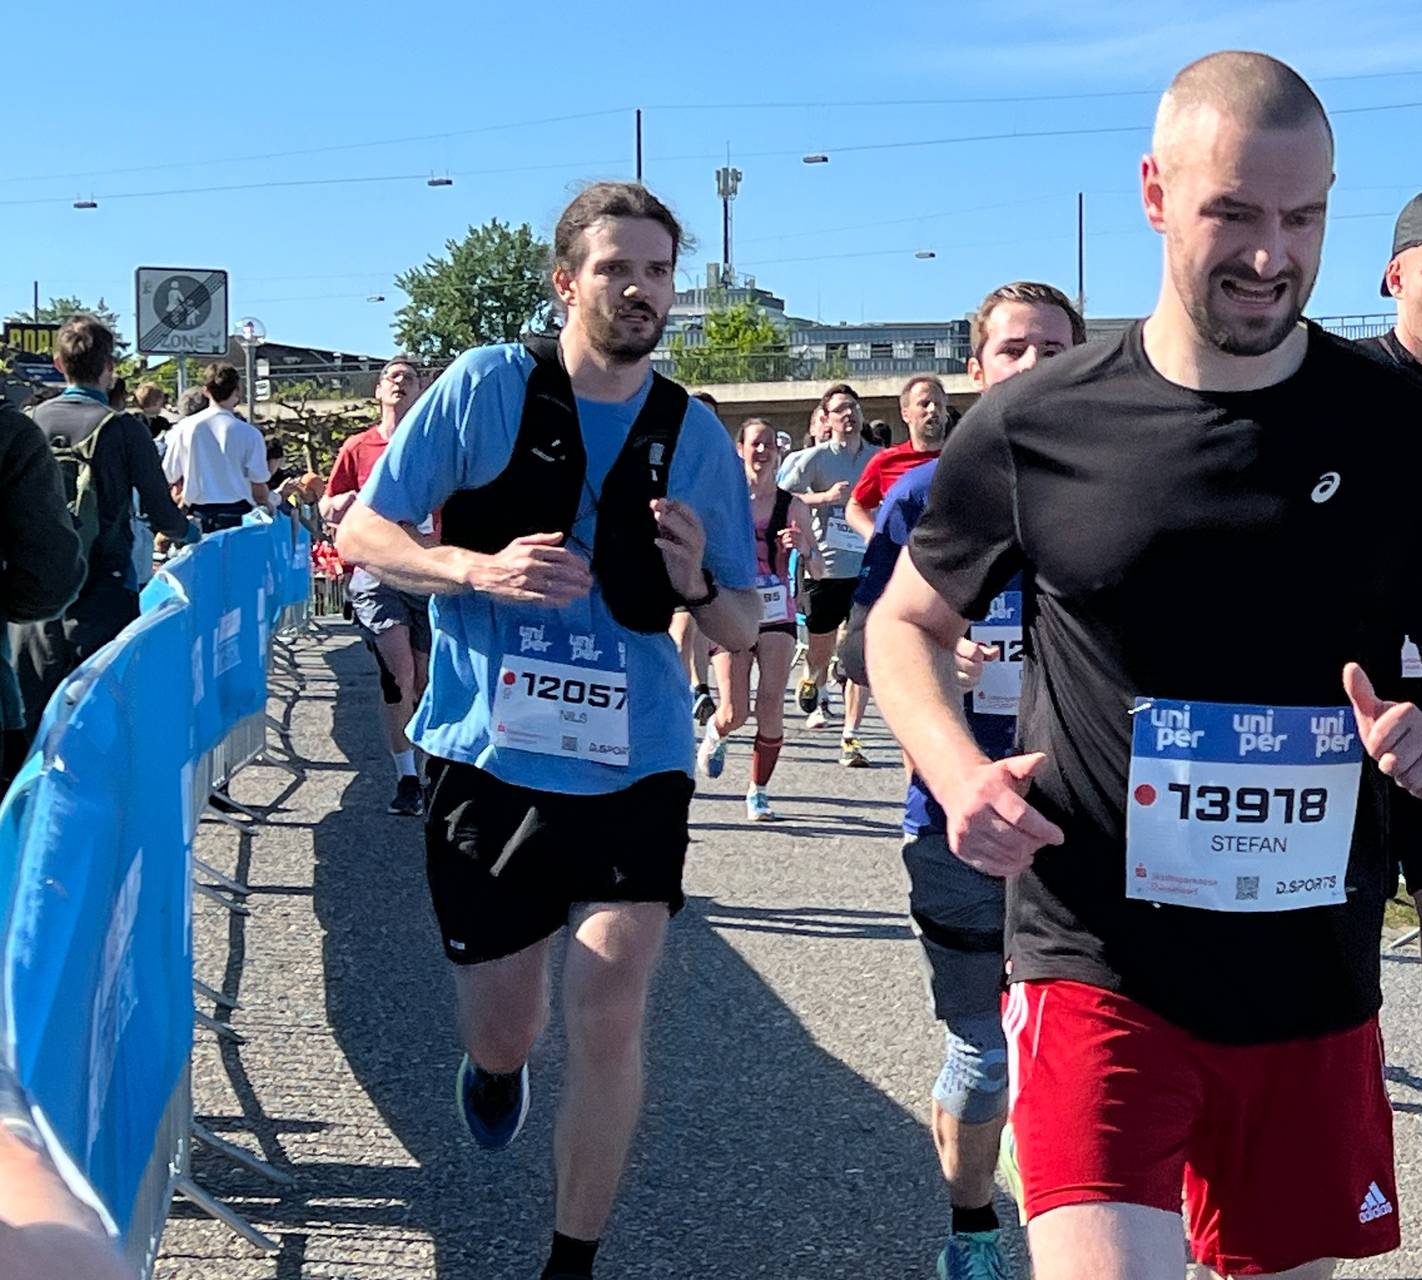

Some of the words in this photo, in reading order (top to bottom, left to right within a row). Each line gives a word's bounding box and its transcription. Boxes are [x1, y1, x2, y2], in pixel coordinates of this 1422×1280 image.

[160, 333, 206, 349] ZONE
[763, 592, 781, 603] 95
[521, 672, 627, 709] 12057
[1151, 704, 1191, 729] uni
[1233, 709, 1273, 734] uni
[1310, 710, 1345, 735] uni
[1156, 728, 1205, 752] per
[1239, 733, 1288, 756] per
[1315, 733, 1354, 758] per
[1168, 783, 1328, 824] 13918
[1210, 835, 1288, 853] STEFAN
[1275, 875, 1337, 896] D.SPORTS
[1359, 1201, 1393, 1224] adidas
